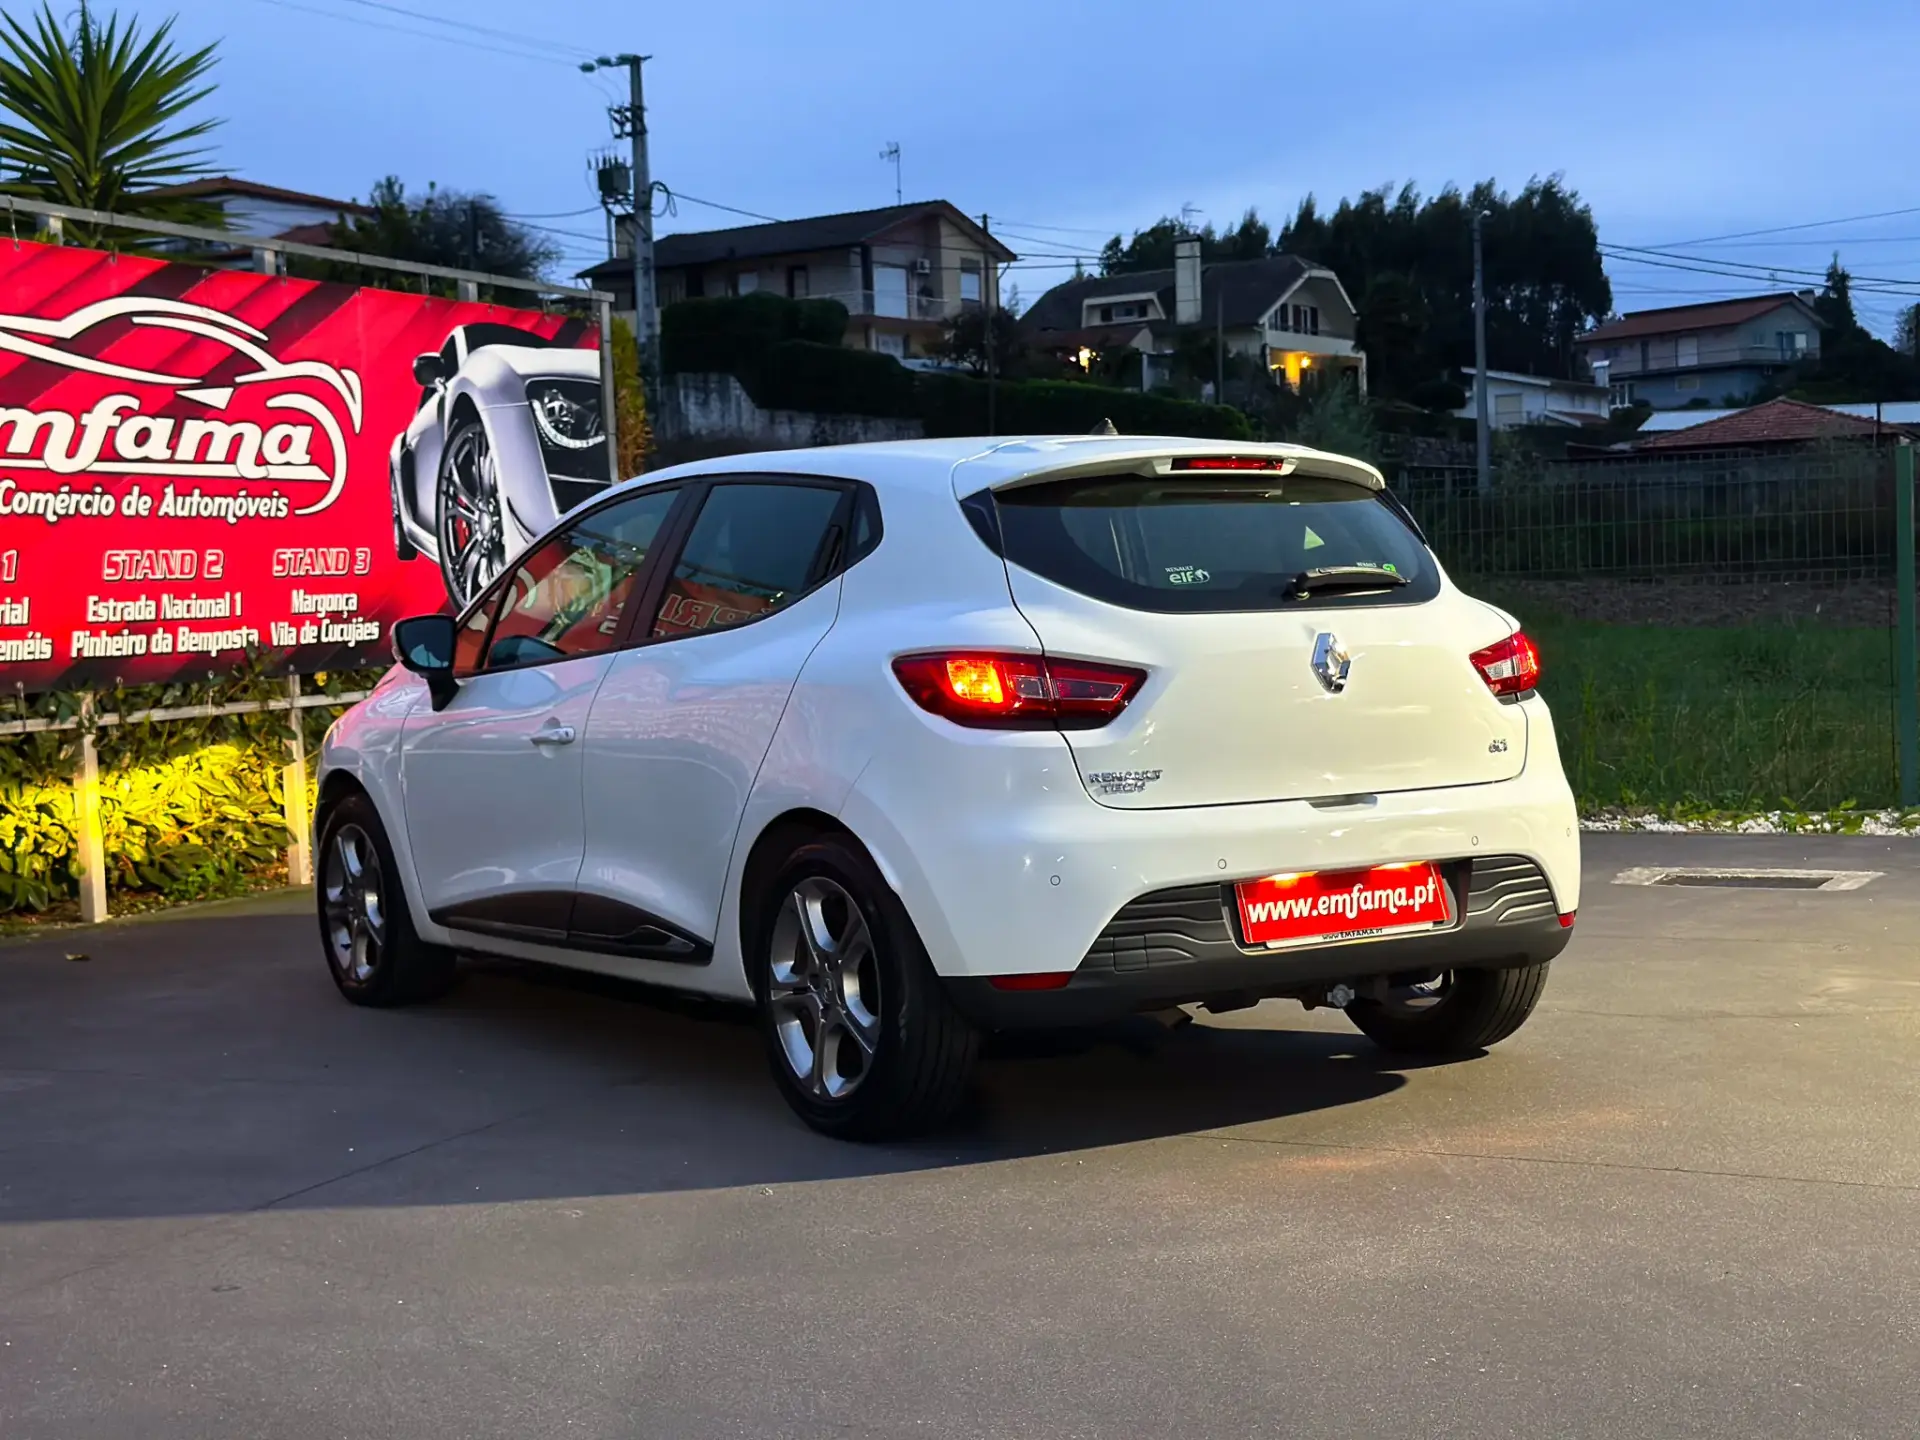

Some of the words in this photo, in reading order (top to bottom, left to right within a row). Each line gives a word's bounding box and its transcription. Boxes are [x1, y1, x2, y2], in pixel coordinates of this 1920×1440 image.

[0, 478, 116, 523] Comércio
[121, 484, 153, 517] de
[157, 483, 289, 525] Automóveis
[3, 549, 18, 582] 1
[103, 549, 198, 581] STAND
[203, 549, 225, 579] 2
[272, 547, 350, 577] STAND
[353, 547, 371, 576] 3
[86, 593, 157, 623] Estrada
[160, 591, 231, 621] Nacional
[234, 591, 243, 617] 1
[70, 628, 148, 659] Pinheiro
[150, 626, 174, 655] da
[177, 625, 260, 658] Bemposta
[269, 620, 297, 647] Vila
[299, 619, 318, 645] de
[320, 616, 381, 649] Cucujães
[1247, 875, 1436, 925] www.emfama.pt
